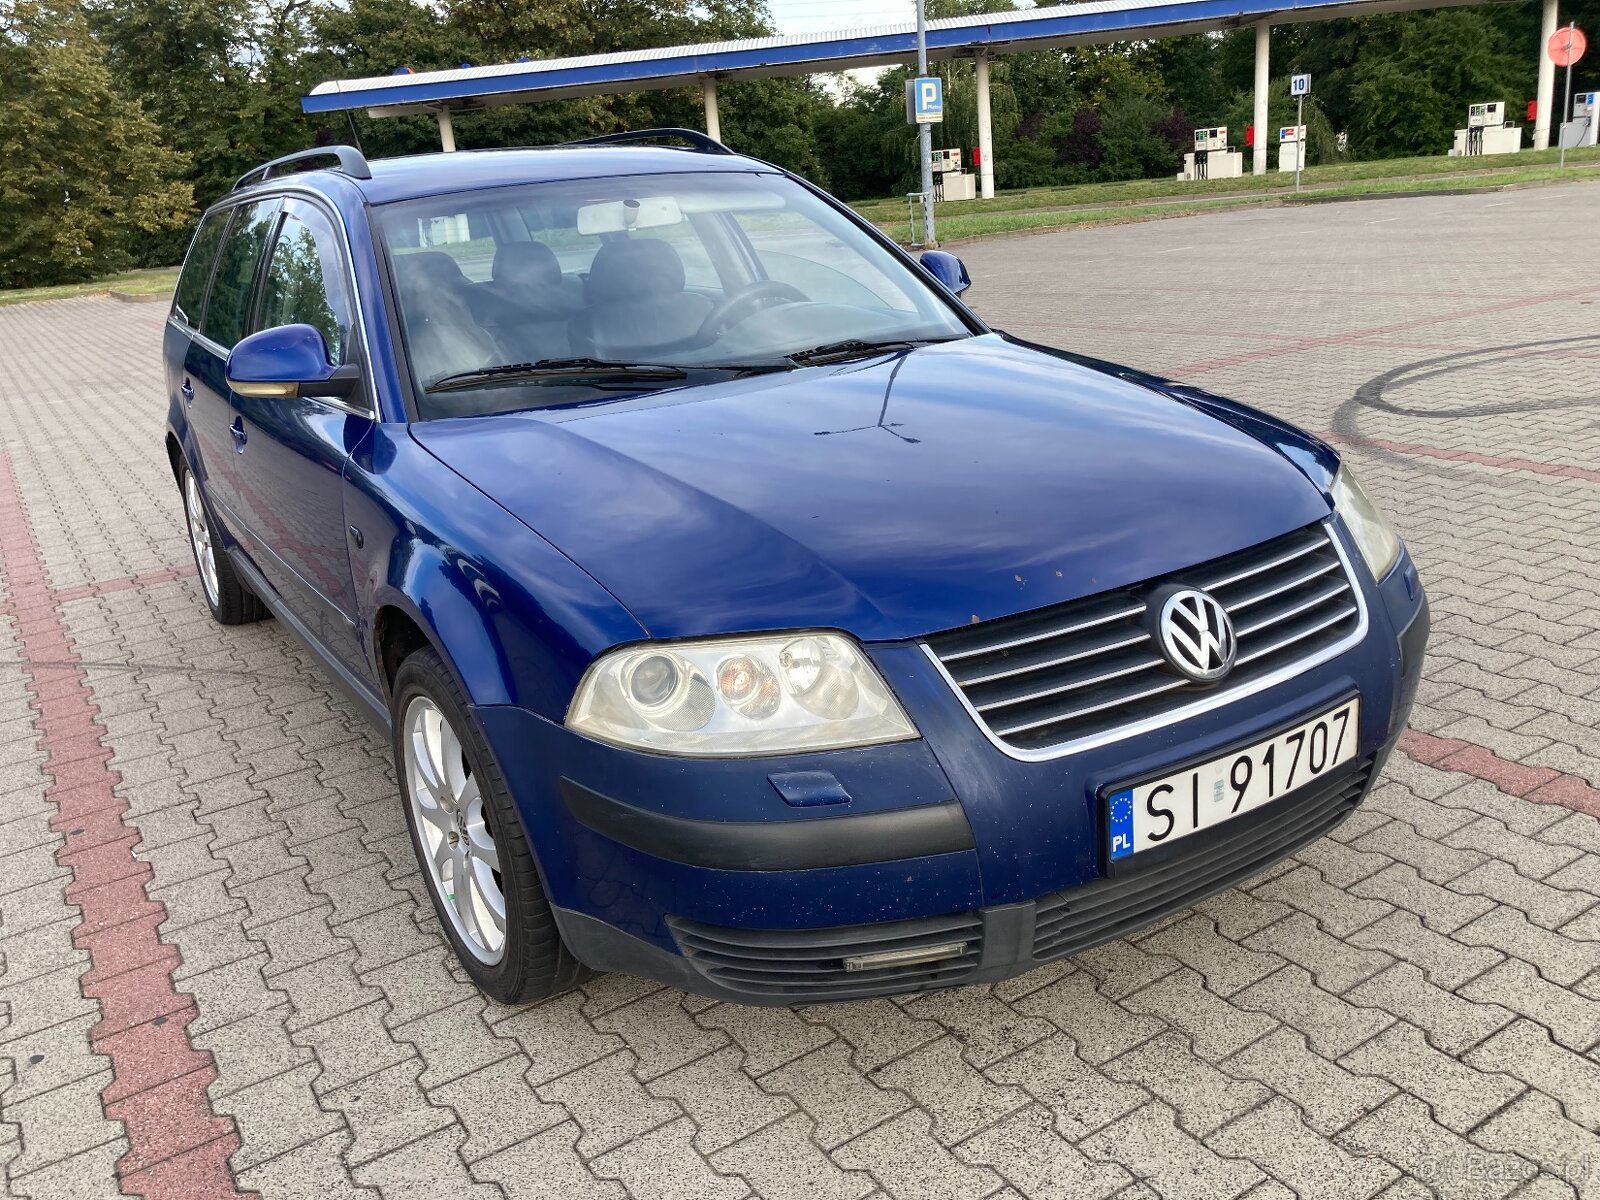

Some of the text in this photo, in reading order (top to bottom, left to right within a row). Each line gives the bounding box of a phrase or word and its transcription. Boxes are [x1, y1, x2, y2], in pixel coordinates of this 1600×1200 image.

[1293, 78, 1305, 91] 10
[921, 83, 937, 111] P
[1146, 706, 1351, 842] SI 91707
[1112, 833, 1131, 853] PL
